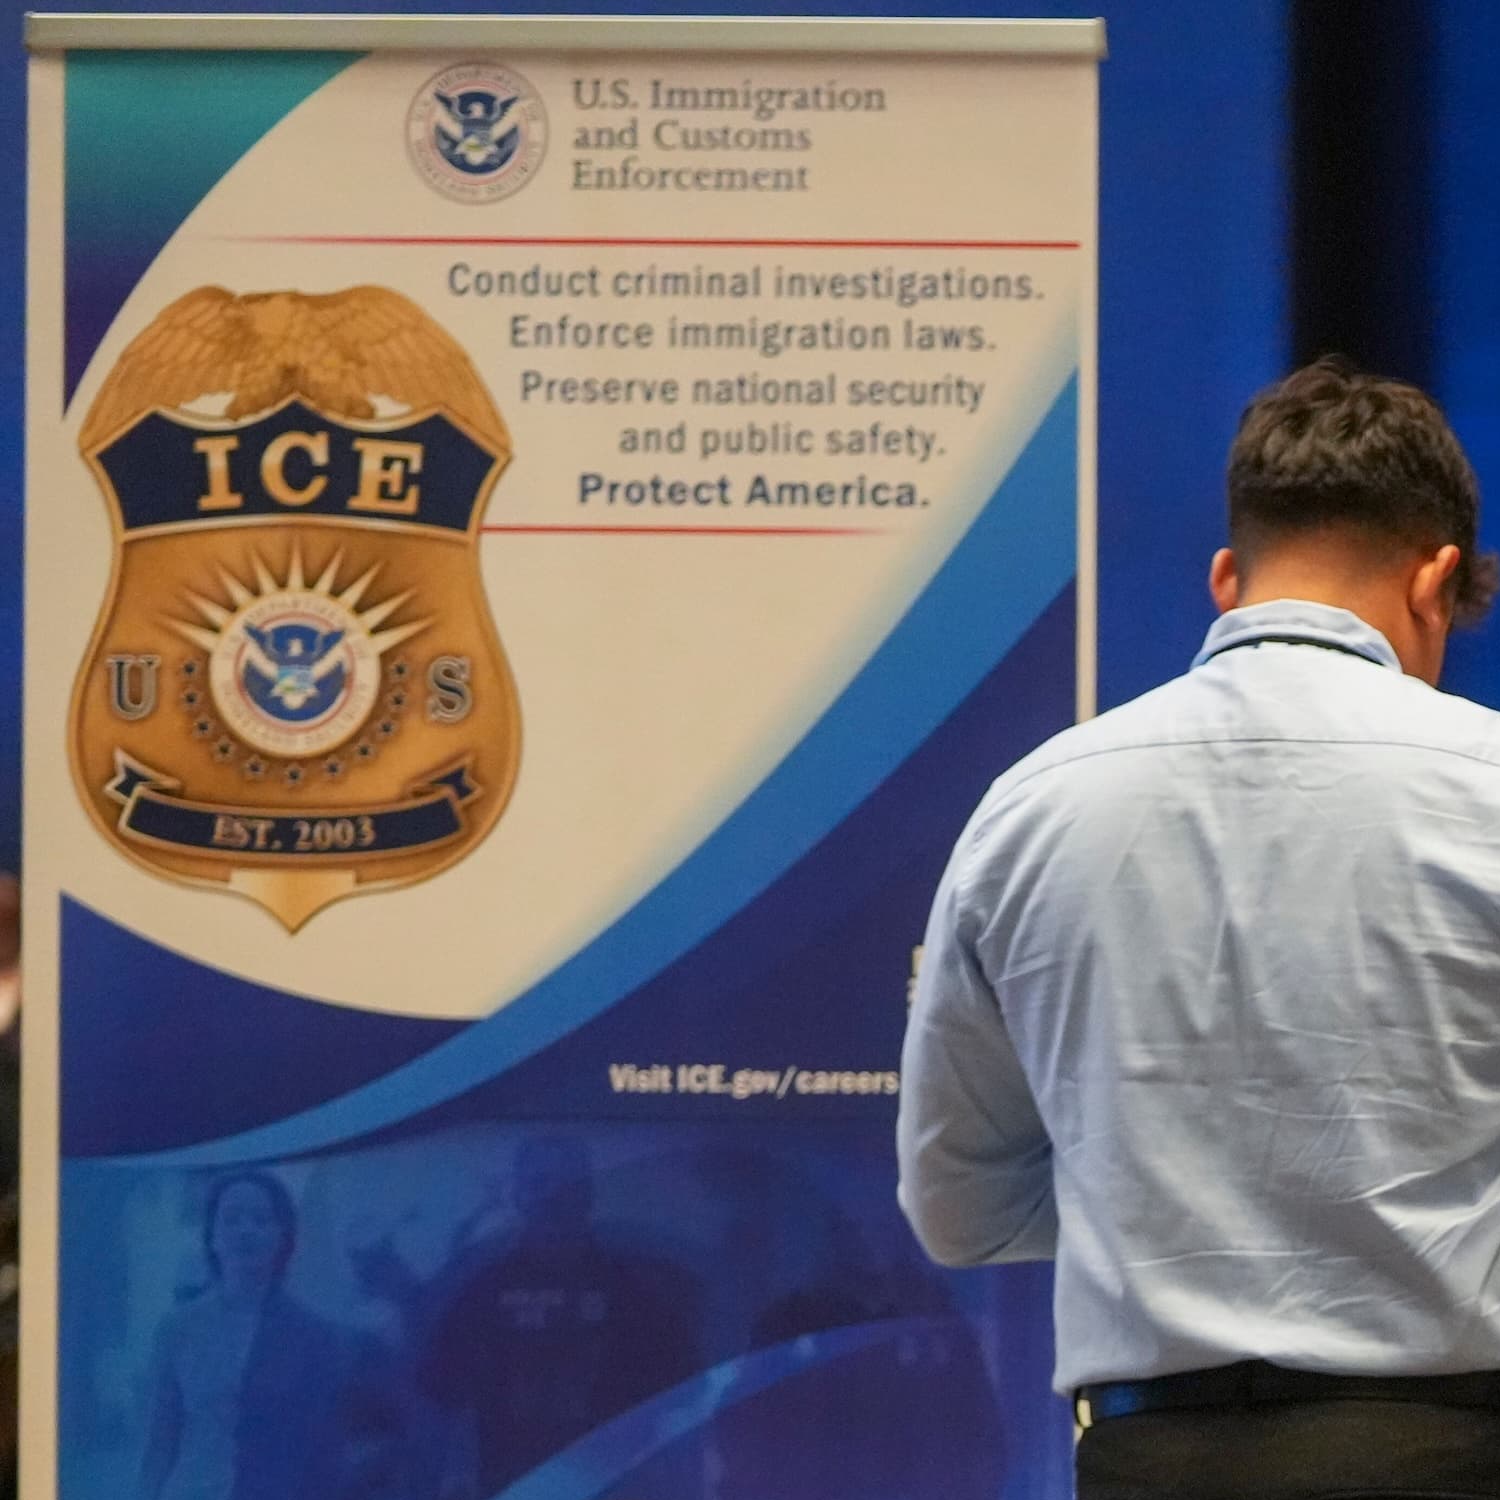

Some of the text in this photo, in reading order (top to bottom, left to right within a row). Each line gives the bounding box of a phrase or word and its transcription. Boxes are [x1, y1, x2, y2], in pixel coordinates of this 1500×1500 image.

[572, 79, 887, 121] U.S. Immigration
[573, 121, 812, 152] and Customs
[571, 158, 811, 193] Enforcement
[448, 264, 1045, 306] Conduct criminal investigations.
[510, 315, 996, 357] Enforce immigration laws.
[521, 370, 985, 412] Preserve national security
[619, 424, 945, 463] and public safety.
[193, 430, 424, 515] ICE
[579, 475, 929, 508] Protect America.
[106, 653, 159, 721] U
[425, 656, 472, 723] S
[212, 813, 376, 851] EST. 2003
[609, 1064, 899, 1099] Visit ICE.gov/careers
